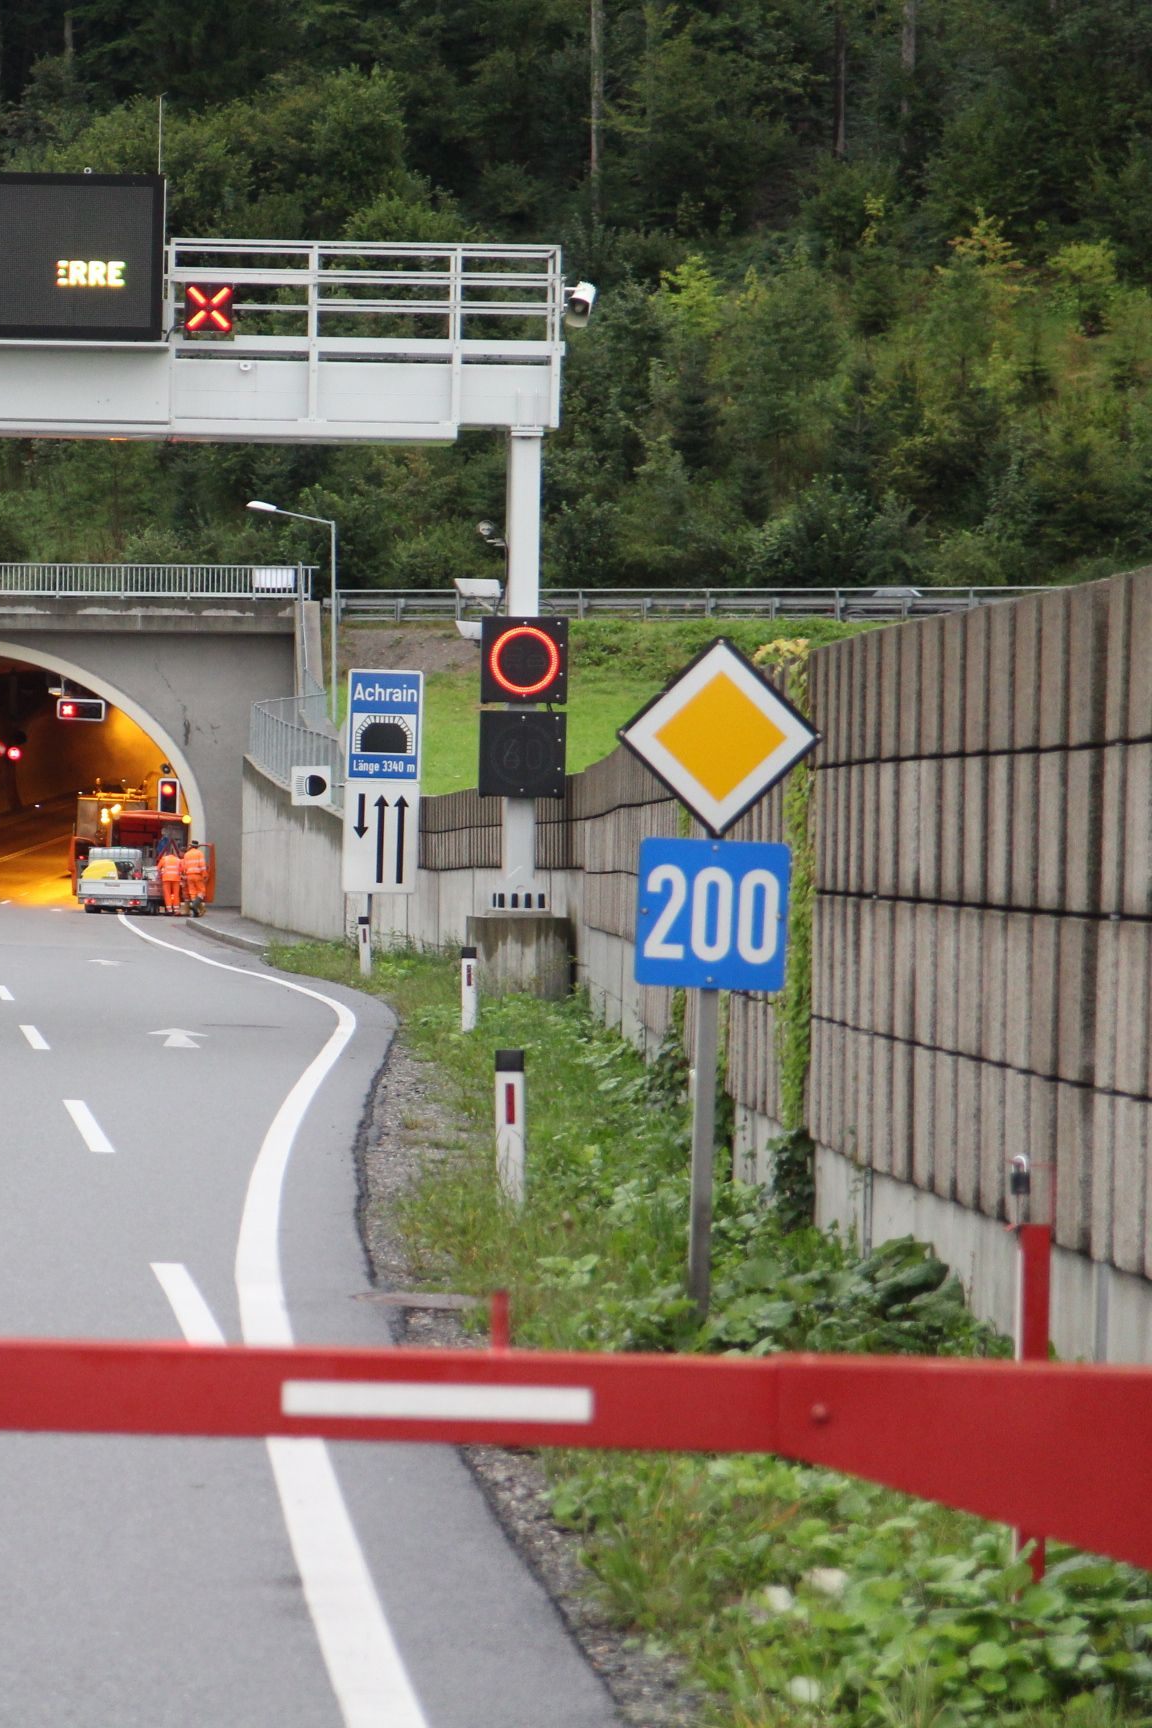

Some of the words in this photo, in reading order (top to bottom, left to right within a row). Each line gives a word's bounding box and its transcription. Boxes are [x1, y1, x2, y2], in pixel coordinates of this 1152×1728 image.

[353, 682, 417, 702] Achrain
[353, 759, 380, 774] Länge
[382, 760, 404, 773] 3340
[406, 763, 416, 773] m
[643, 864, 780, 964] 200
